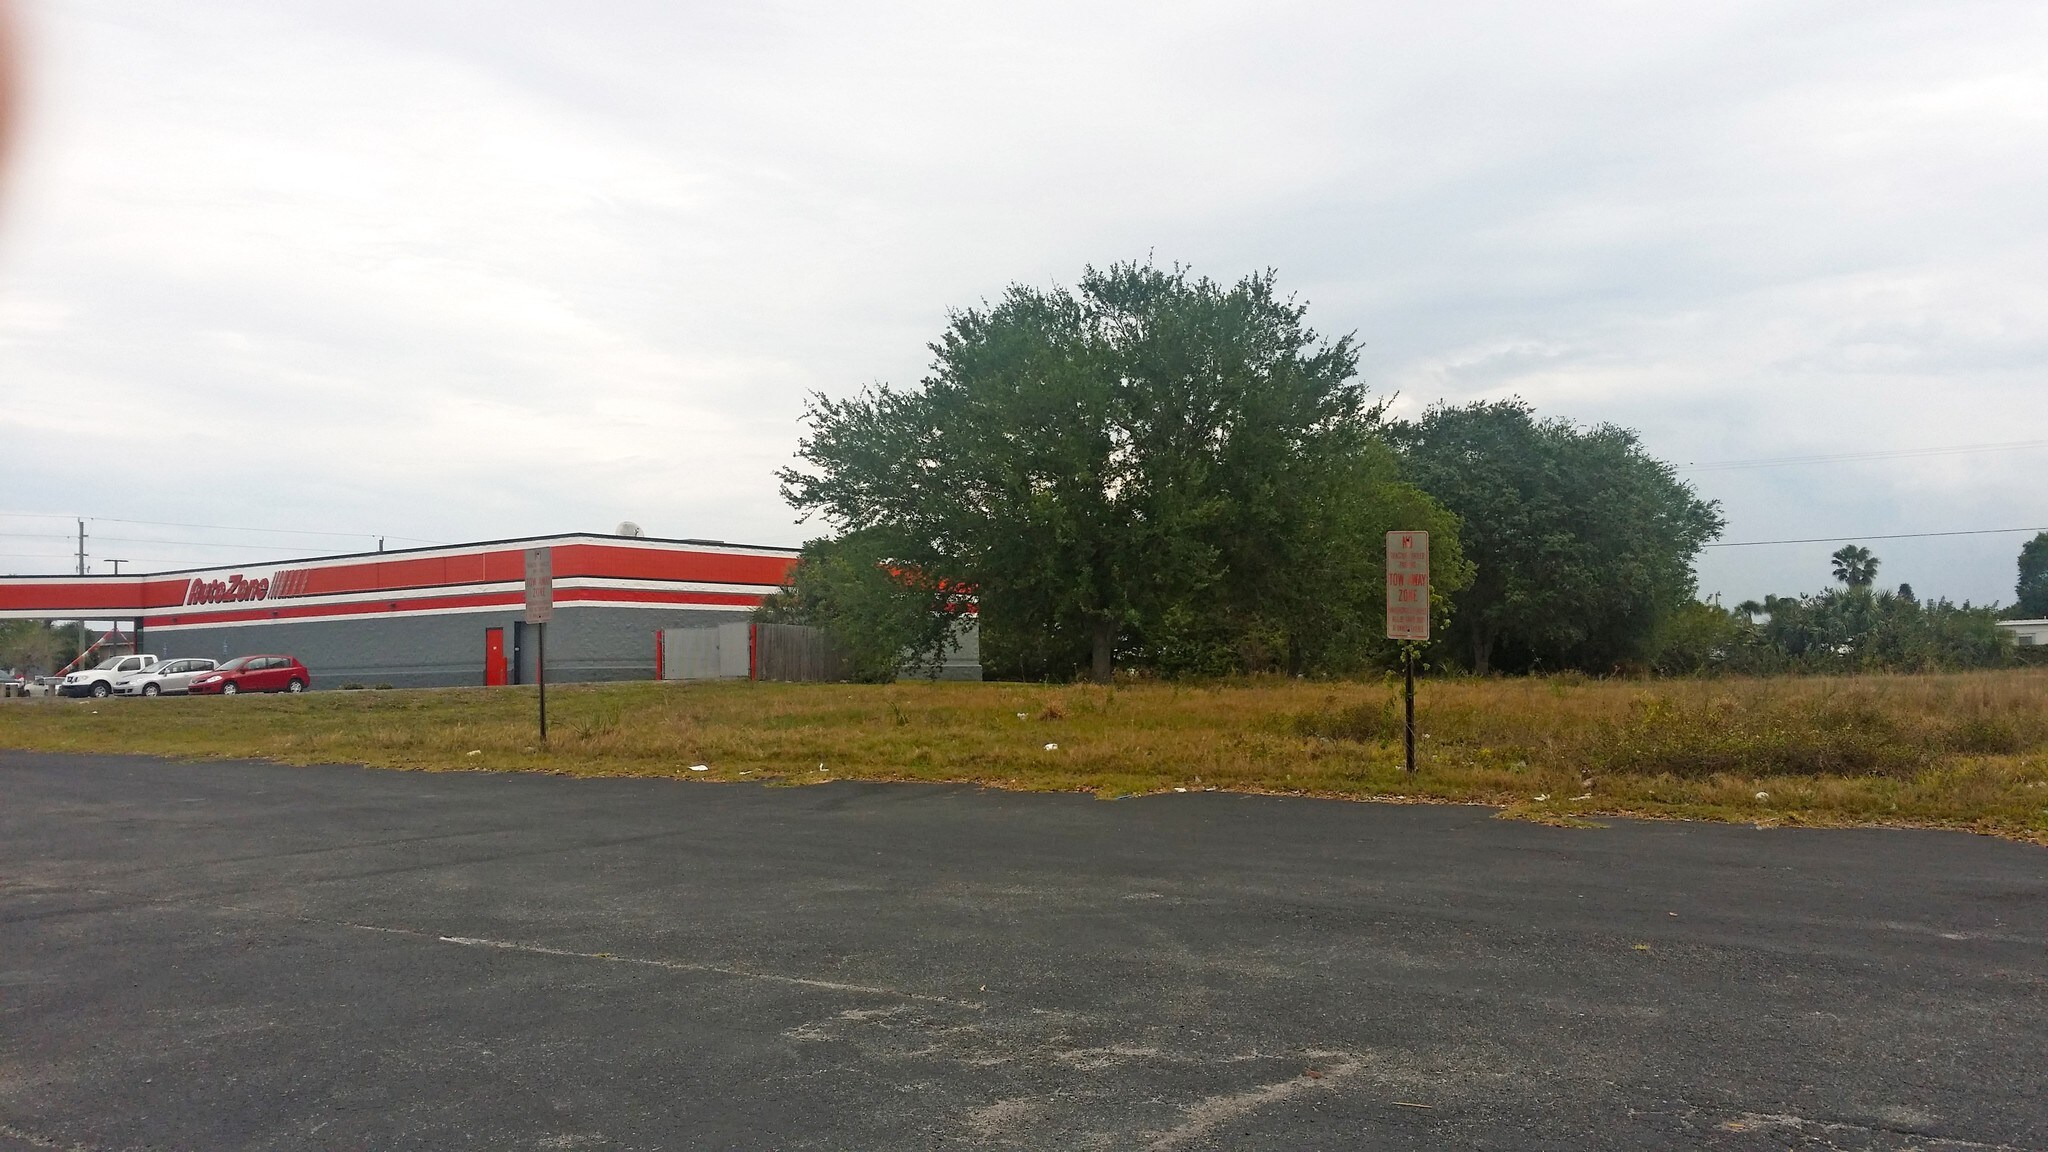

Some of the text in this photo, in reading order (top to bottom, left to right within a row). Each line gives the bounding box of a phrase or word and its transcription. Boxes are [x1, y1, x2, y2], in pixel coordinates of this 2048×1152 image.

[1389, 573, 1404, 586] TOW
[187, 574, 269, 605] AutoZone
[1399, 589, 1417, 601] ZONE
